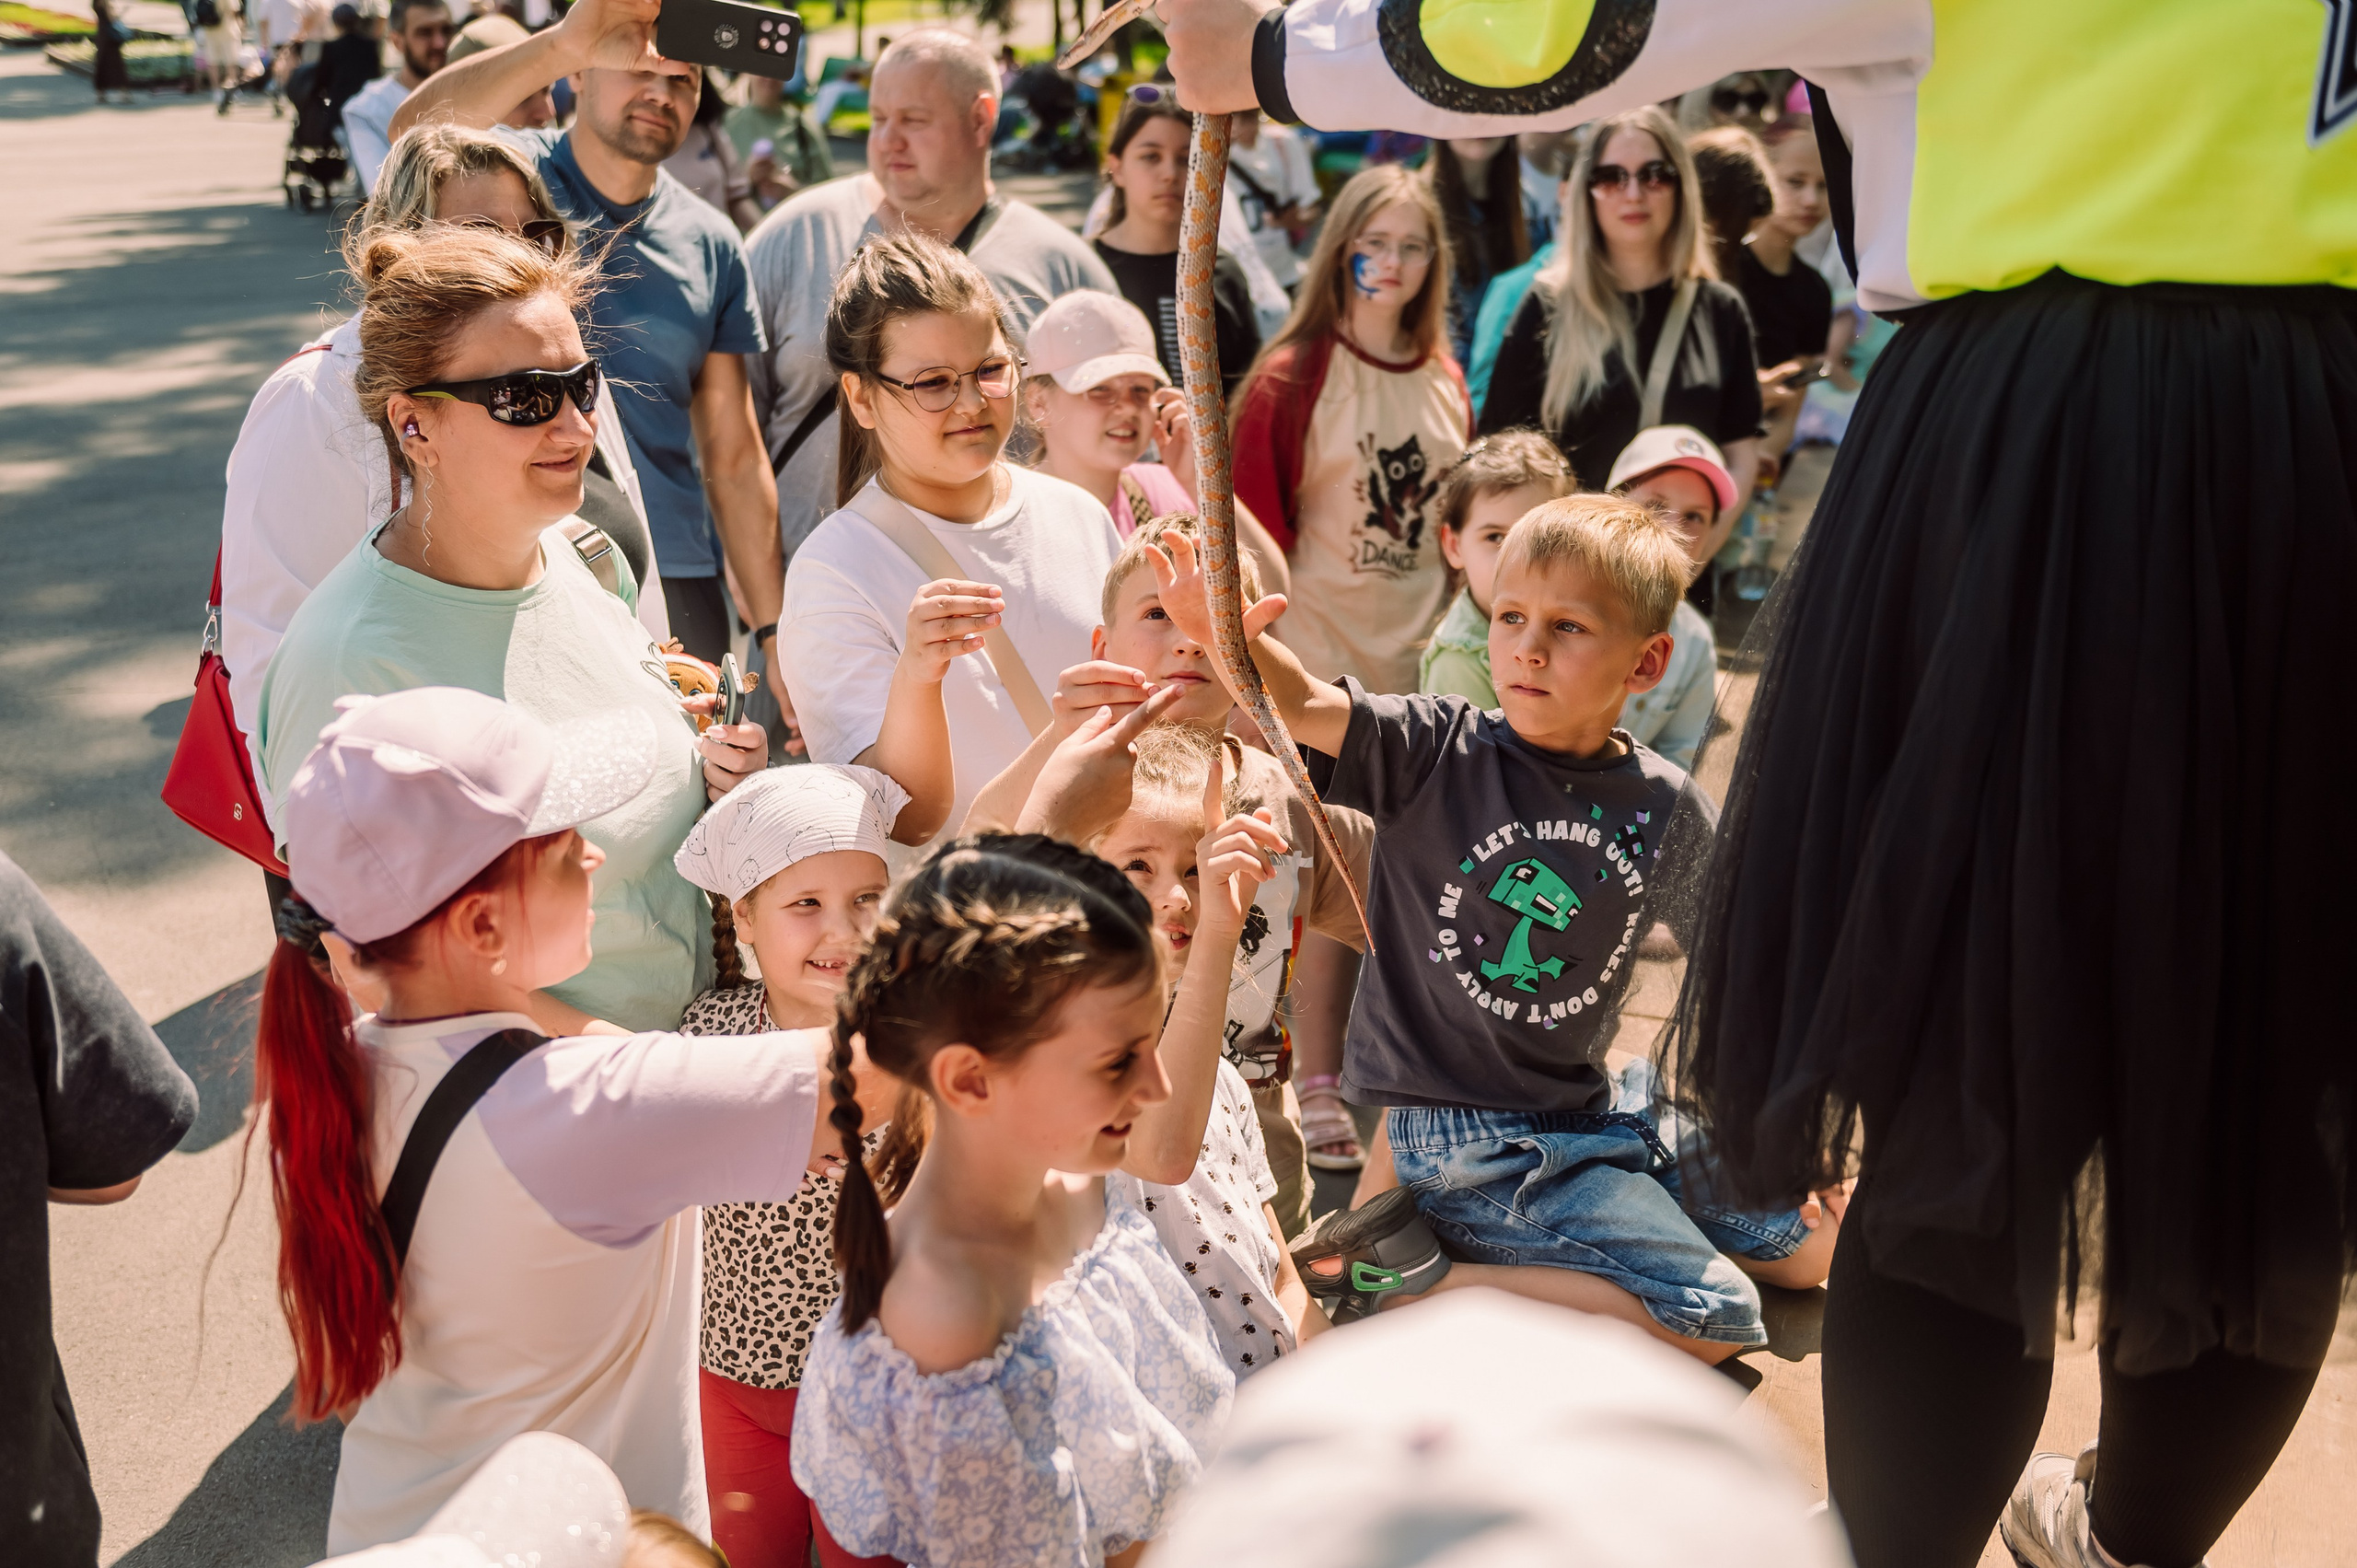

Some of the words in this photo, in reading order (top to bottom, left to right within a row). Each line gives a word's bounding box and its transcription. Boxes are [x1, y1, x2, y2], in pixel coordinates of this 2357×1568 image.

[1362, 540, 1419, 572] DANCE
[1536, 819, 1601, 847] HANG
[1605, 842, 1644, 898] OUT!
[1437, 882, 1463, 919] ME
[1438, 928, 1462, 962] TO
[1456, 970, 1519, 1020] APPLY
[1527, 986, 1599, 1023] DON'T
